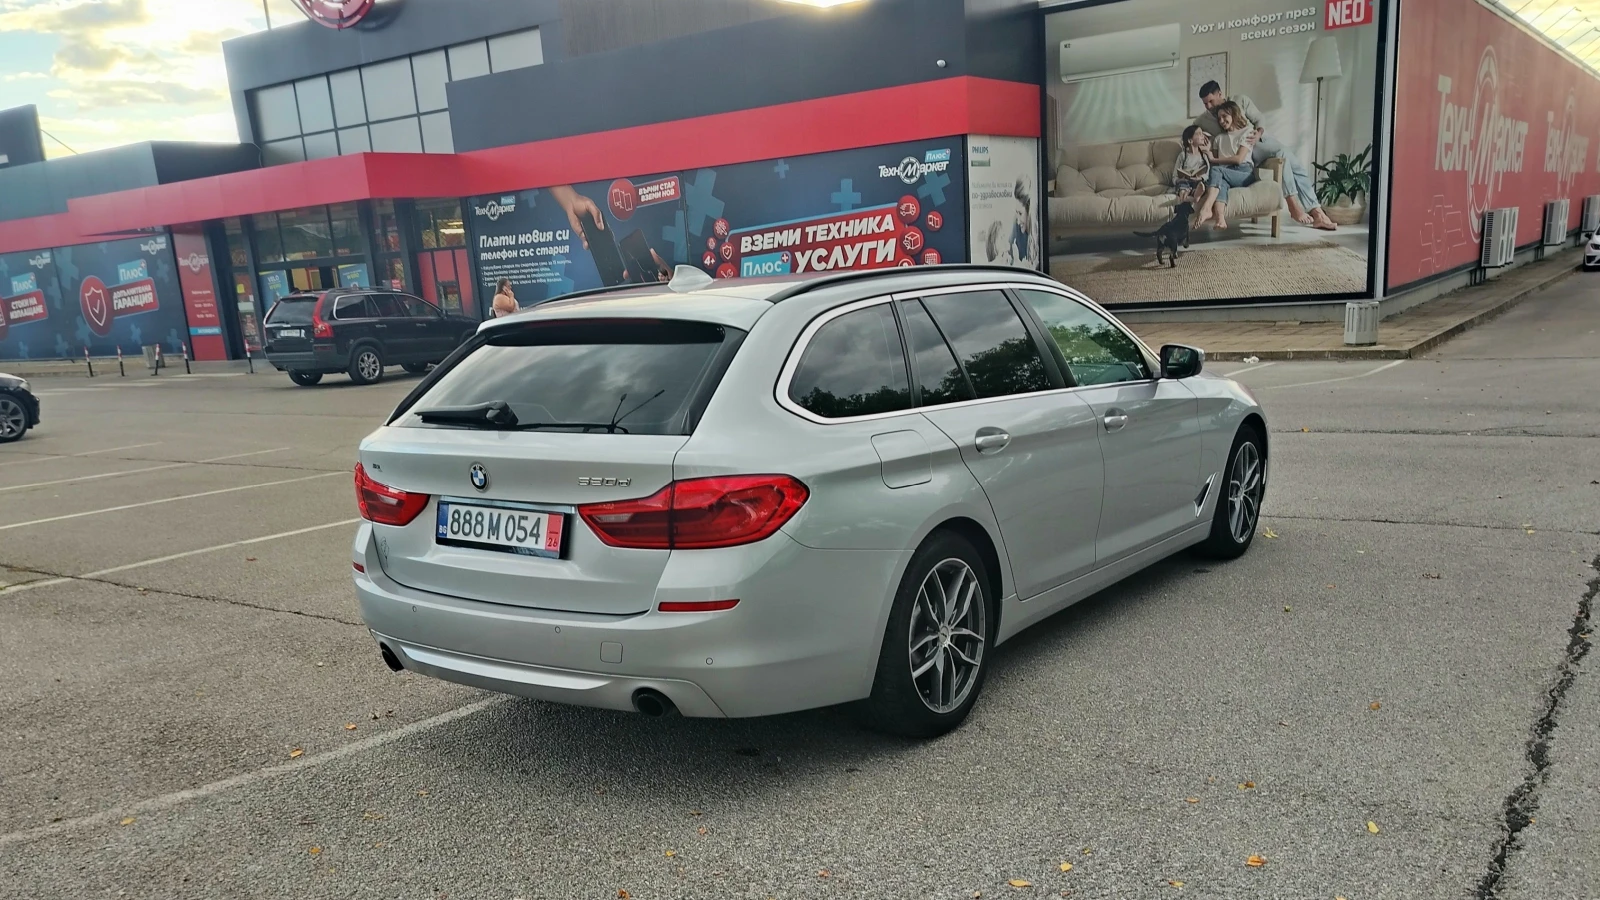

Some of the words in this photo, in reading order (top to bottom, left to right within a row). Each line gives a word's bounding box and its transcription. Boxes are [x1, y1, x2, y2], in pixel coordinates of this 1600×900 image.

[1191, 24, 1214, 34] Уют
[1217, 21, 1225, 30] и
[1228, 14, 1283, 29] комфорт
[1286, 7, 1316, 21] през
[1328, 0, 1365, 26] NEO
[1241, 29, 1276, 41] всеки
[1279, 22, 1315, 35] сезон
[660, 181, 675, 190] СТАР
[662, 188, 675, 197] НОВ
[480, 234, 516, 248] Плати
[518, 230, 554, 245] новия
[556, 229, 570, 241] си
[741, 228, 801, 253] ВЗЕМИ
[805, 214, 895, 244] ТЕХНИКА
[480, 249, 518, 260] телефон
[519, 248, 535, 258] със
[536, 245, 570, 257] стария
[795, 238, 897, 274] УСЛУГИ
[119, 267, 144, 281] Плюс
[743, 261, 783, 277] Плюс
[13, 280, 34, 293] Плюс
[114, 293, 154, 310] ГАРАНЦИЯ
[438, 525, 447, 534] BG
[450, 508, 485, 538] 888
[487, 512, 502, 541] M
[504, 514, 542, 545] 054
[547, 537, 558, 548] 26
